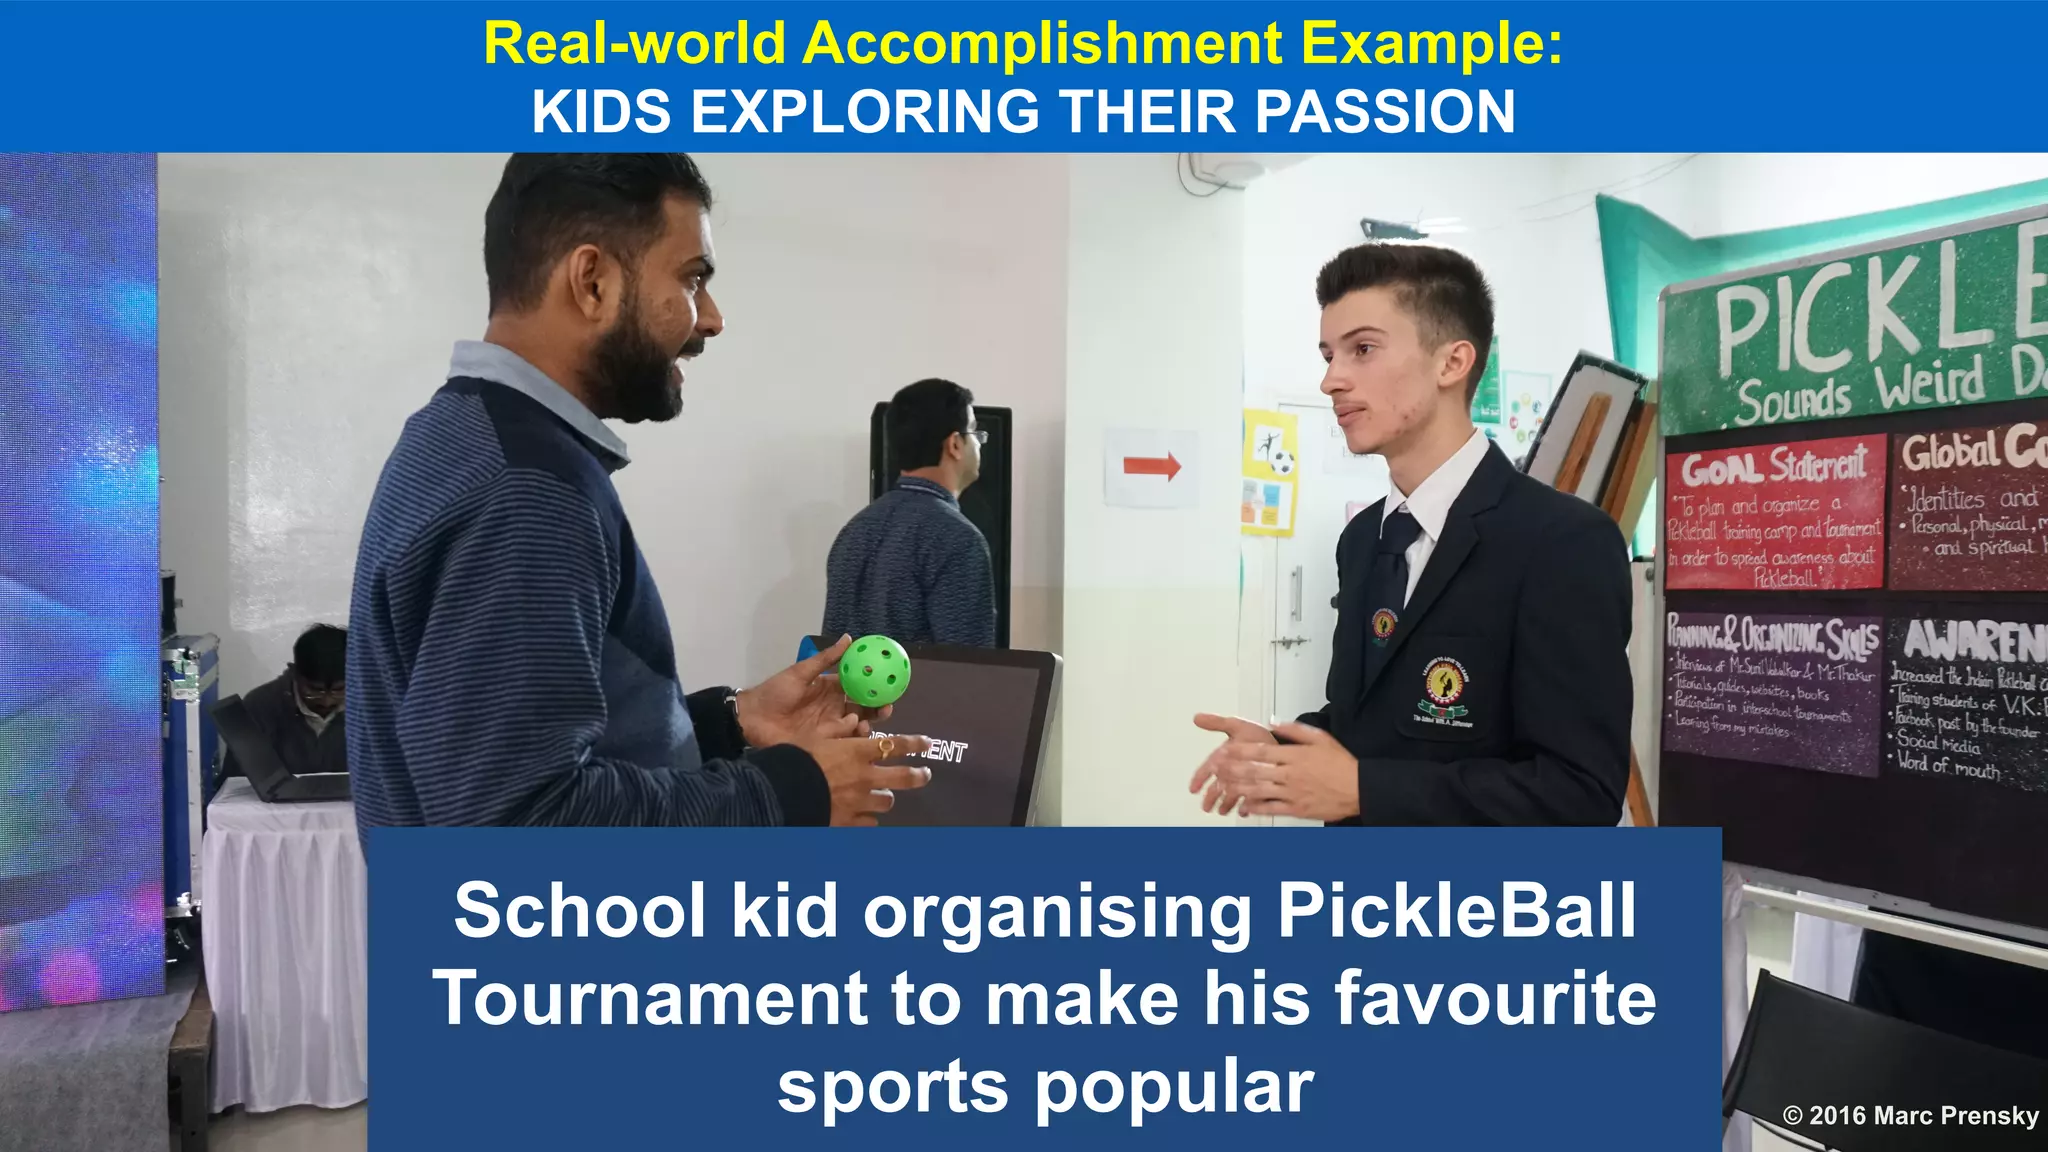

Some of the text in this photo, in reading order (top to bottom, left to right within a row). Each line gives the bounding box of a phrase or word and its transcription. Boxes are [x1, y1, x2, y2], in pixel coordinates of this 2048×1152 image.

[1716, 219, 2048, 379] PICKLE
[1734, 378, 1853, 427] Sounds
[1874, 353, 1986, 410] Weird
[1902, 429, 2002, 472] Global
[1682, 442, 1869, 488] GOAL Statement
[1699, 497, 1725, 522] plan
[1732, 494, 1759, 515] and
[1763, 496, 1820, 518] organize
[1831, 497, 1842, 511] a
[2000, 485, 2040, 508] and
[1722, 519, 1763, 544] training
[1764, 525, 1798, 545] camp
[1801, 520, 1822, 538] and
[1824, 515, 1882, 539] tournament
[1681, 548, 1710, 567] order
[1713, 546, 1729, 565] to
[1731, 548, 1768, 568] spread
[1771, 552, 1834, 566] awareness
[1839, 544, 1876, 566] about
[1935, 540, 1963, 556] and
[1968, 539, 2035, 561] spiritual
[1715, 659, 1726, 673] of
[1947, 665, 1963, 686] the
[1727, 700, 1737, 713] in
[1797, 687, 1830, 702] books
[1932, 693, 1979, 709] students
[1981, 699, 1997, 711] of
[1675, 711, 1790, 738] Learning from my mistakes
[1938, 716, 1962, 735] post
[1965, 712, 1980, 738] by
[1982, 716, 1997, 730] the
[1998, 718, 2041, 738] founder
[1897, 729, 1939, 749] Social
[1897, 749, 2001, 783] Word of mouth
